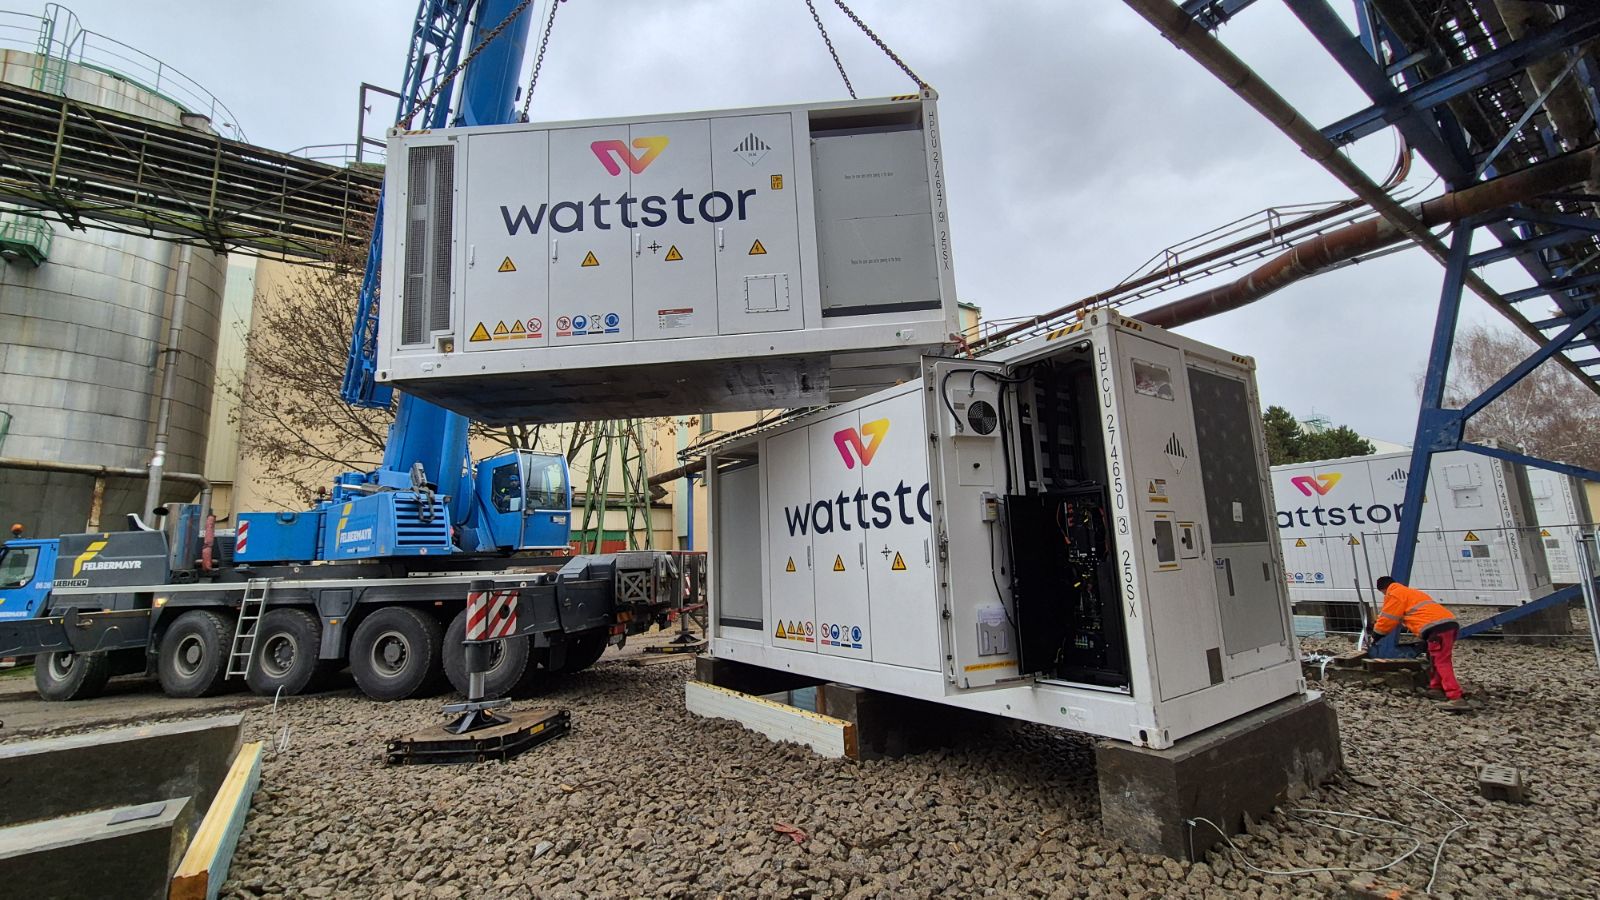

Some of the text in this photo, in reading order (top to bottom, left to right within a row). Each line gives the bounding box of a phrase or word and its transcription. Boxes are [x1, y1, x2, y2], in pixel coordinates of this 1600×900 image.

[500, 187, 757, 236] wattstor
[928, 111, 937, 148] HPCU
[933, 152, 943, 207] 274647
[941, 231, 950, 271] 25SX
[1099, 347, 1112, 408] HPCU
[1107, 414, 1124, 510] 274650
[1122, 550, 1137, 618] 25SX
[785, 479, 932, 537] wattsto
[1277, 502, 1404, 529] attstor
[53, 579, 88, 587] LIEBHERR
[82, 560, 141, 571] FELBERMAYR
